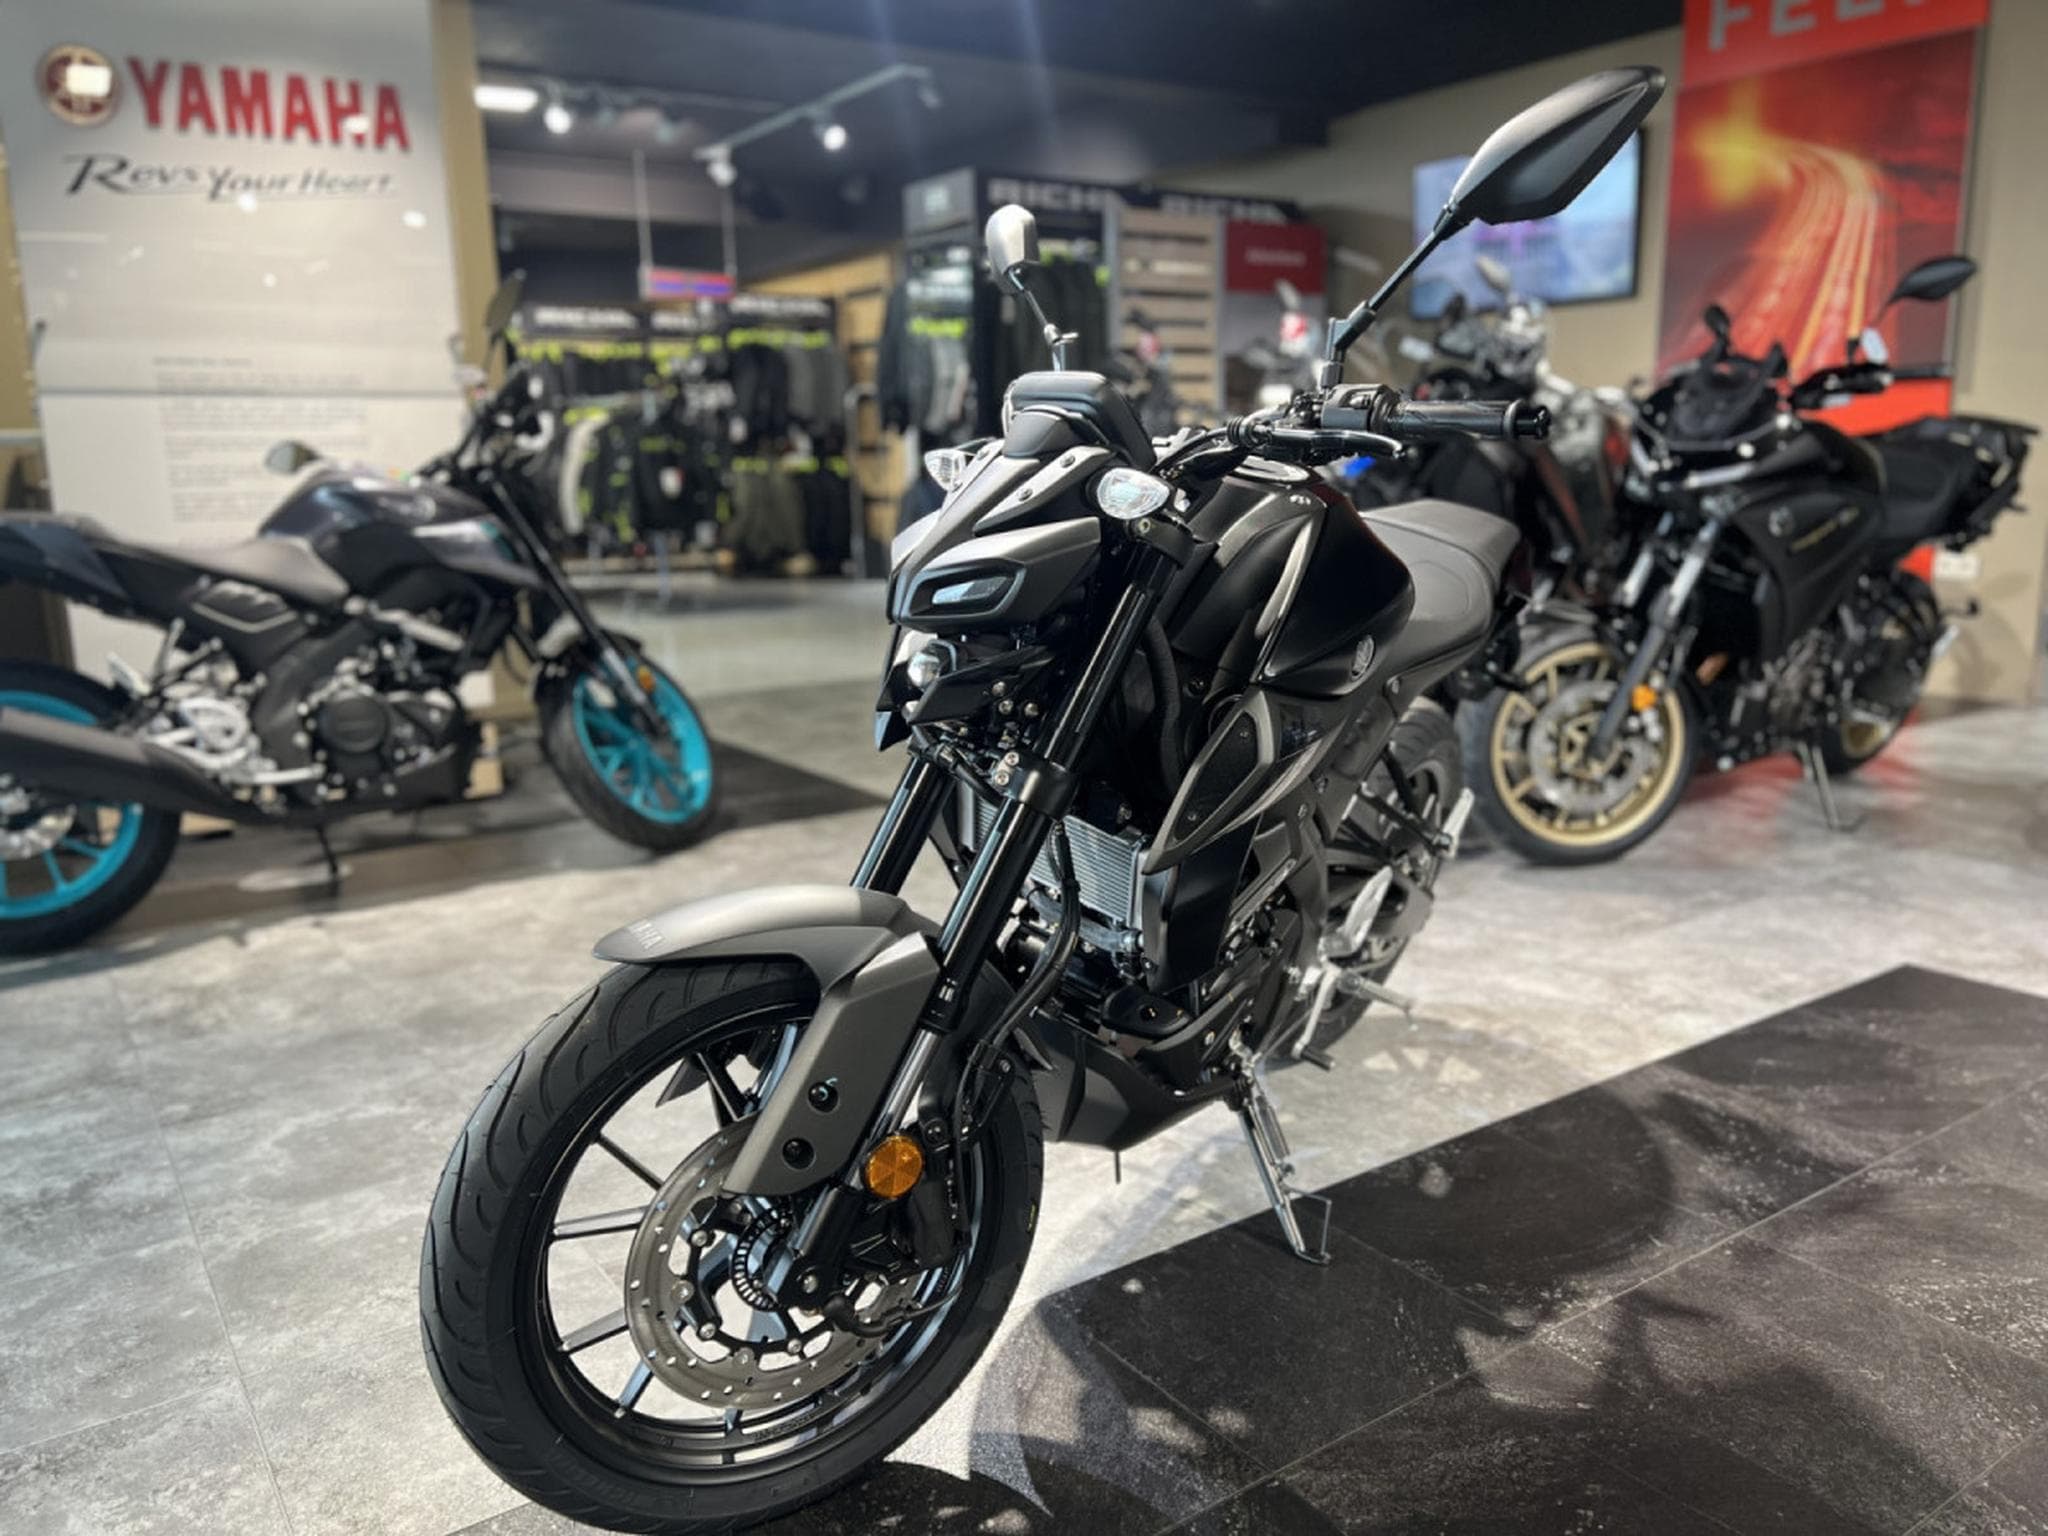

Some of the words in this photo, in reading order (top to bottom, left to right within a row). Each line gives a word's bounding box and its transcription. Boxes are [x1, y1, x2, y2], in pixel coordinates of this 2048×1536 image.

[127, 54, 411, 153] YAMAHA
[65, 153, 201, 195] Revs
[206, 165, 290, 201] Your
[299, 168, 398, 194] Heart
